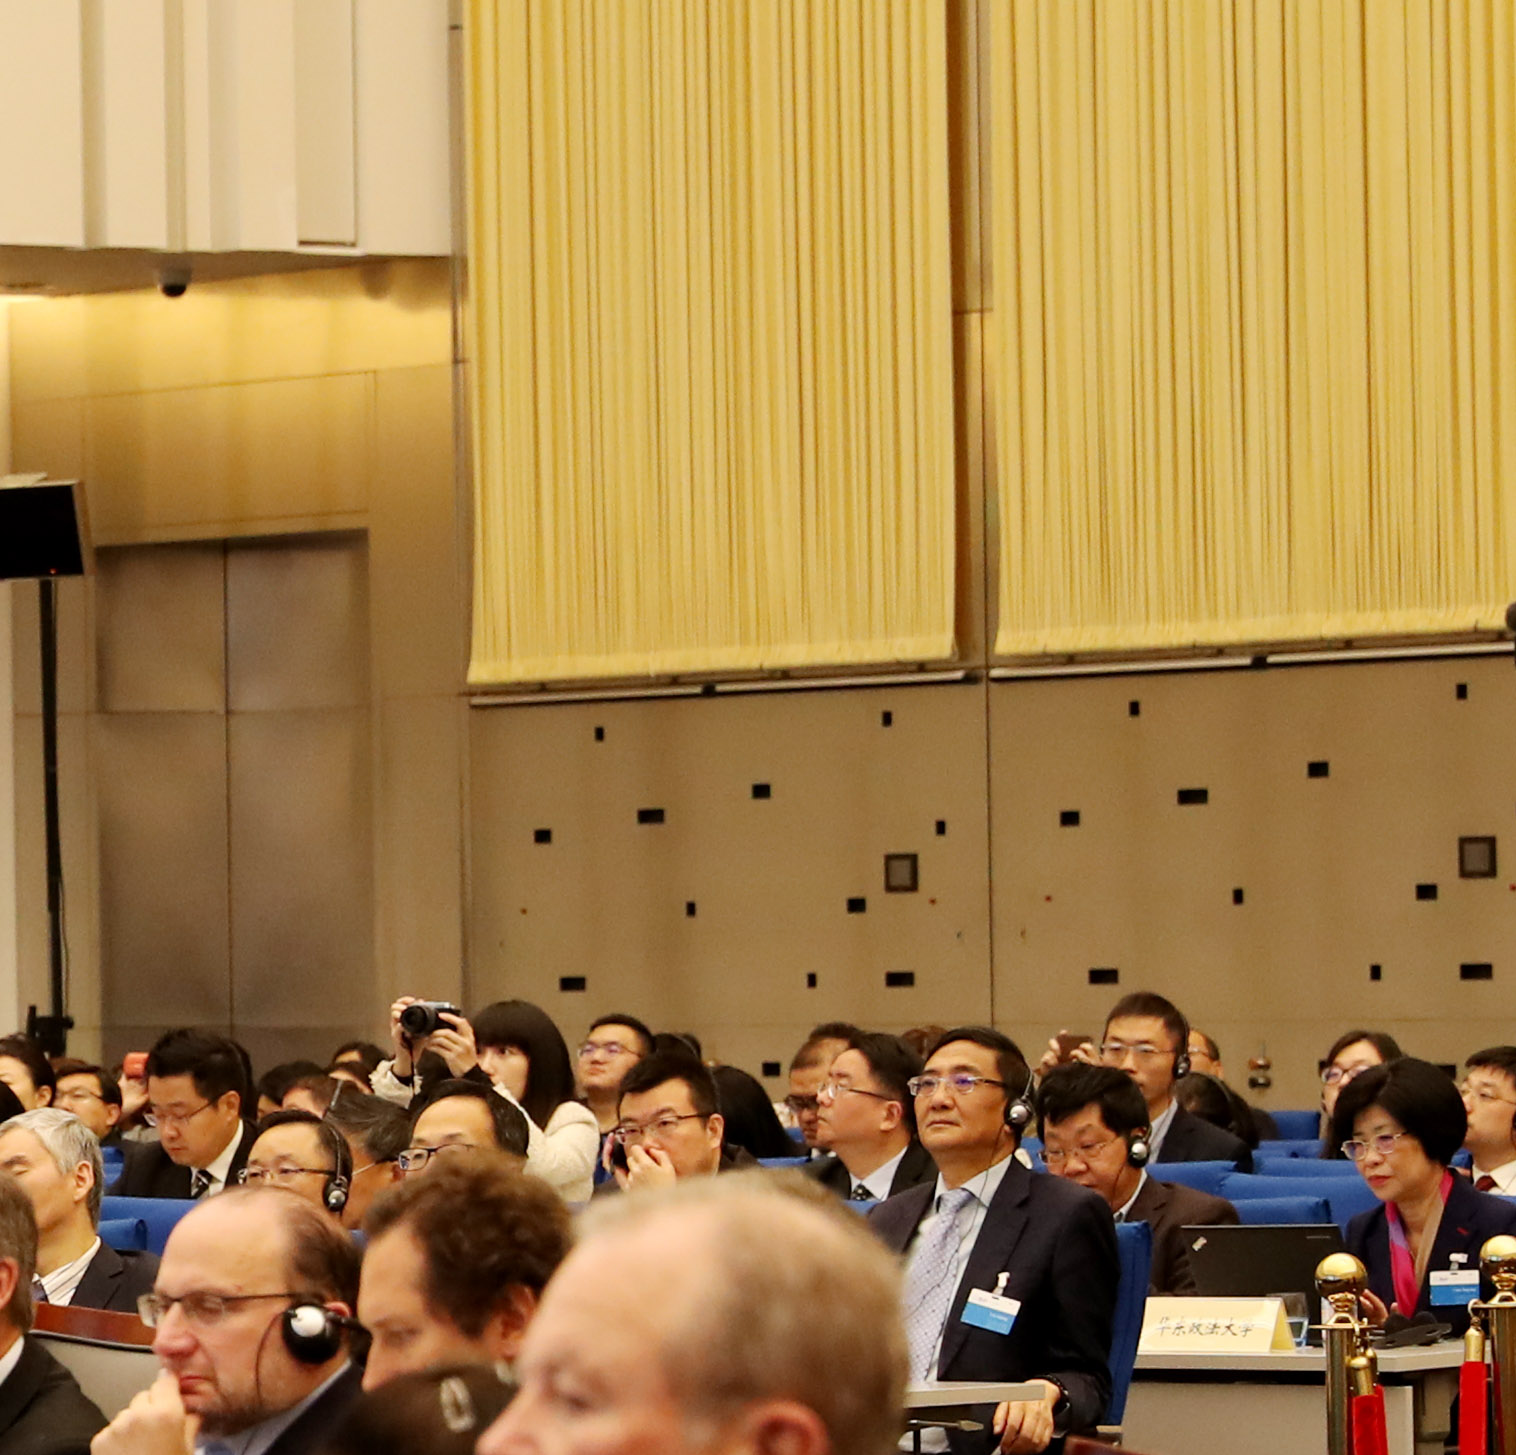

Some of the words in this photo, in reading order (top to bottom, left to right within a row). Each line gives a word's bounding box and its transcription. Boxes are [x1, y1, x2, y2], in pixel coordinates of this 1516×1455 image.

[1156, 1316, 1255, 1338] 华东政法大学
